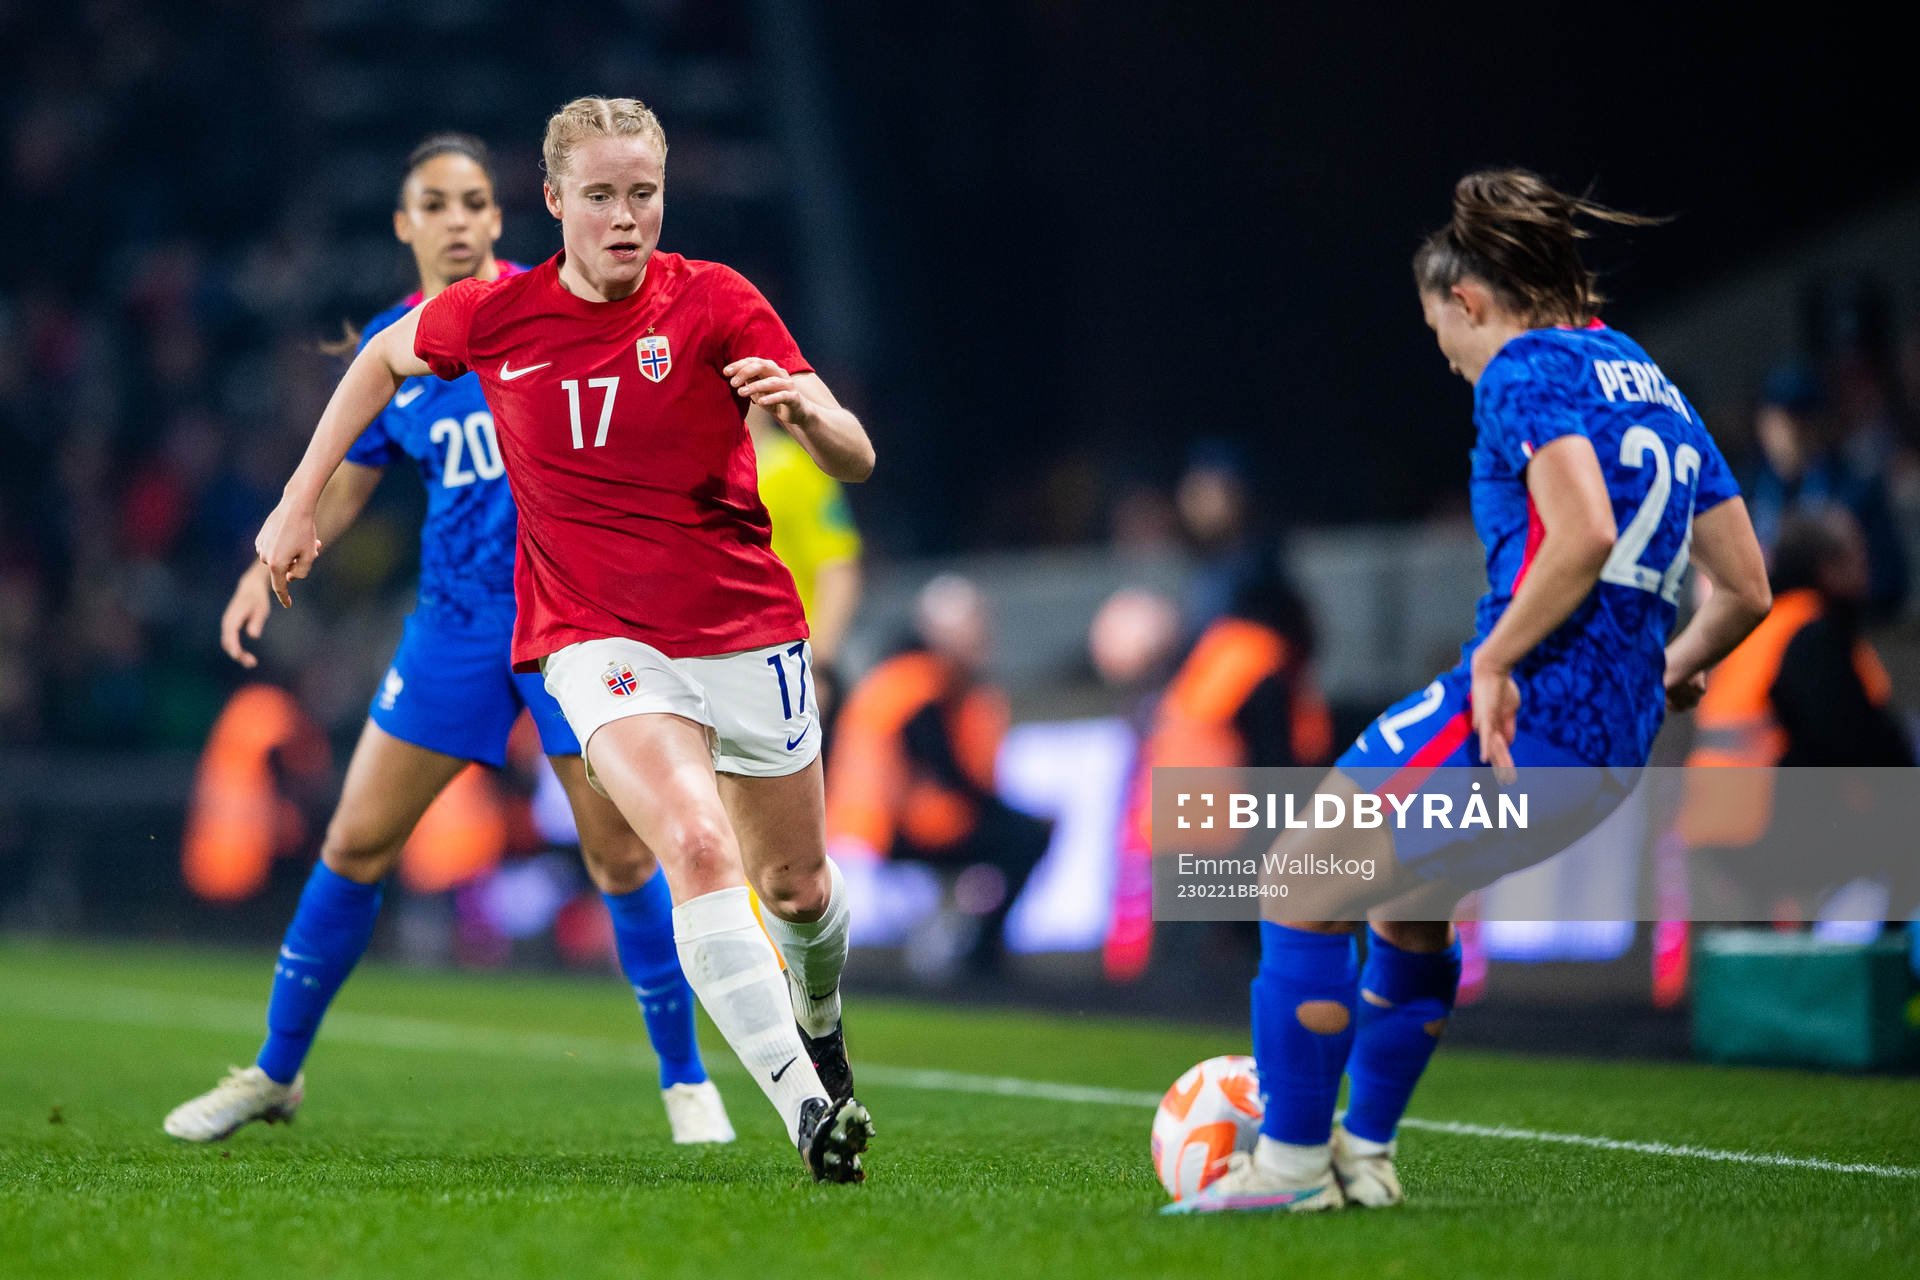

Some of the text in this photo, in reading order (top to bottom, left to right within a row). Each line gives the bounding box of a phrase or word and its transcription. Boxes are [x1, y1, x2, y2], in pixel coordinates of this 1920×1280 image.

[429, 411, 505, 489] 20
[561, 376, 620, 449] 17
[1600, 425, 1701, 607] 22
[767, 642, 806, 720] 17
